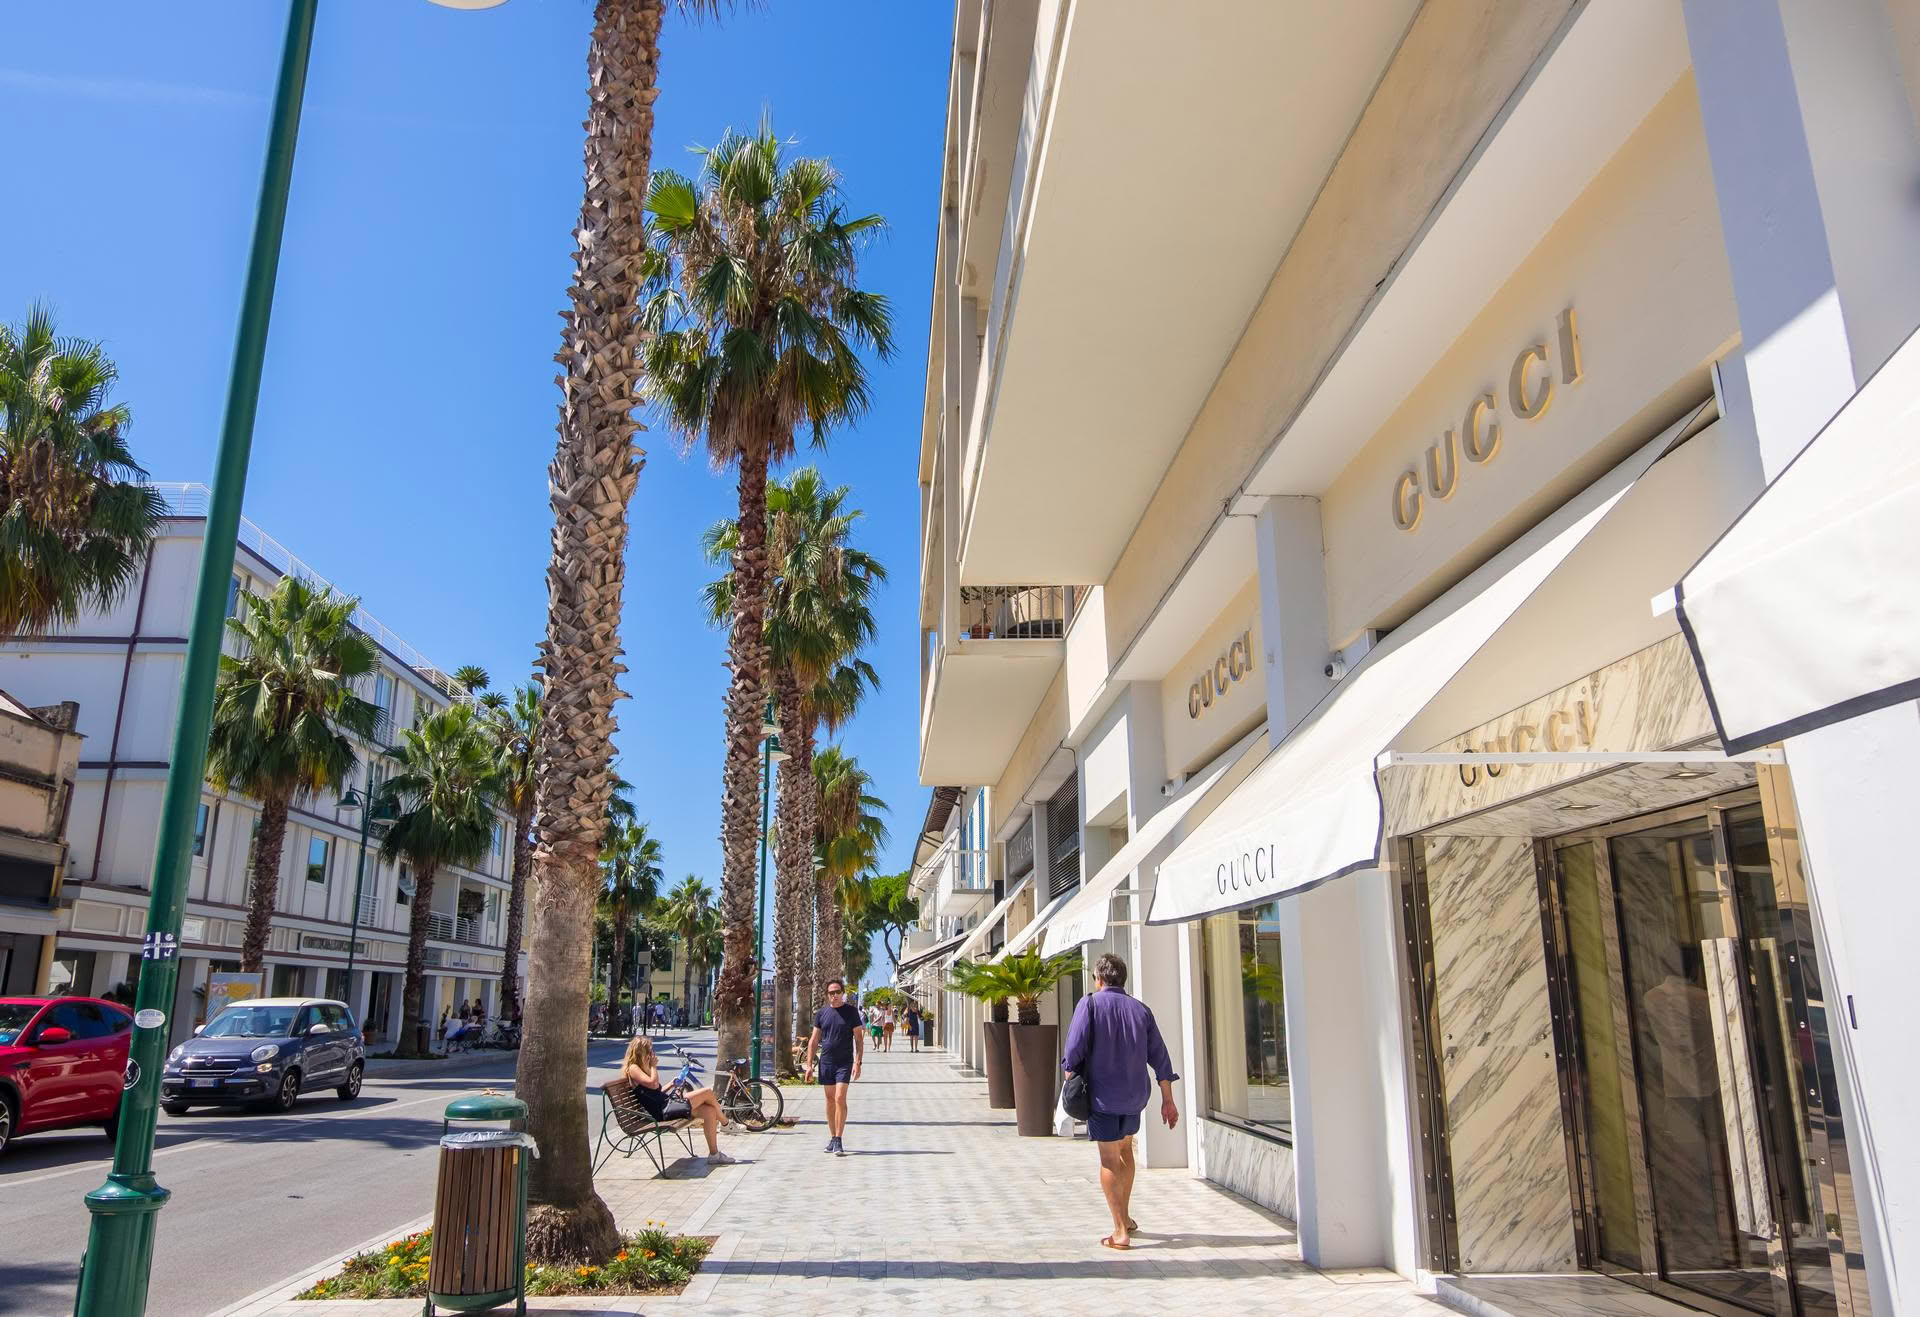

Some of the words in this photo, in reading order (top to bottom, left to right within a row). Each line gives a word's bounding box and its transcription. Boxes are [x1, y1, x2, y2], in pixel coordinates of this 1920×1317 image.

[1392, 308, 1584, 531] GUCCI
[1188, 630, 1254, 719] GUCCI
[1458, 700, 1591, 787] GUCCI
[1217, 844, 1275, 895] GUCCI
